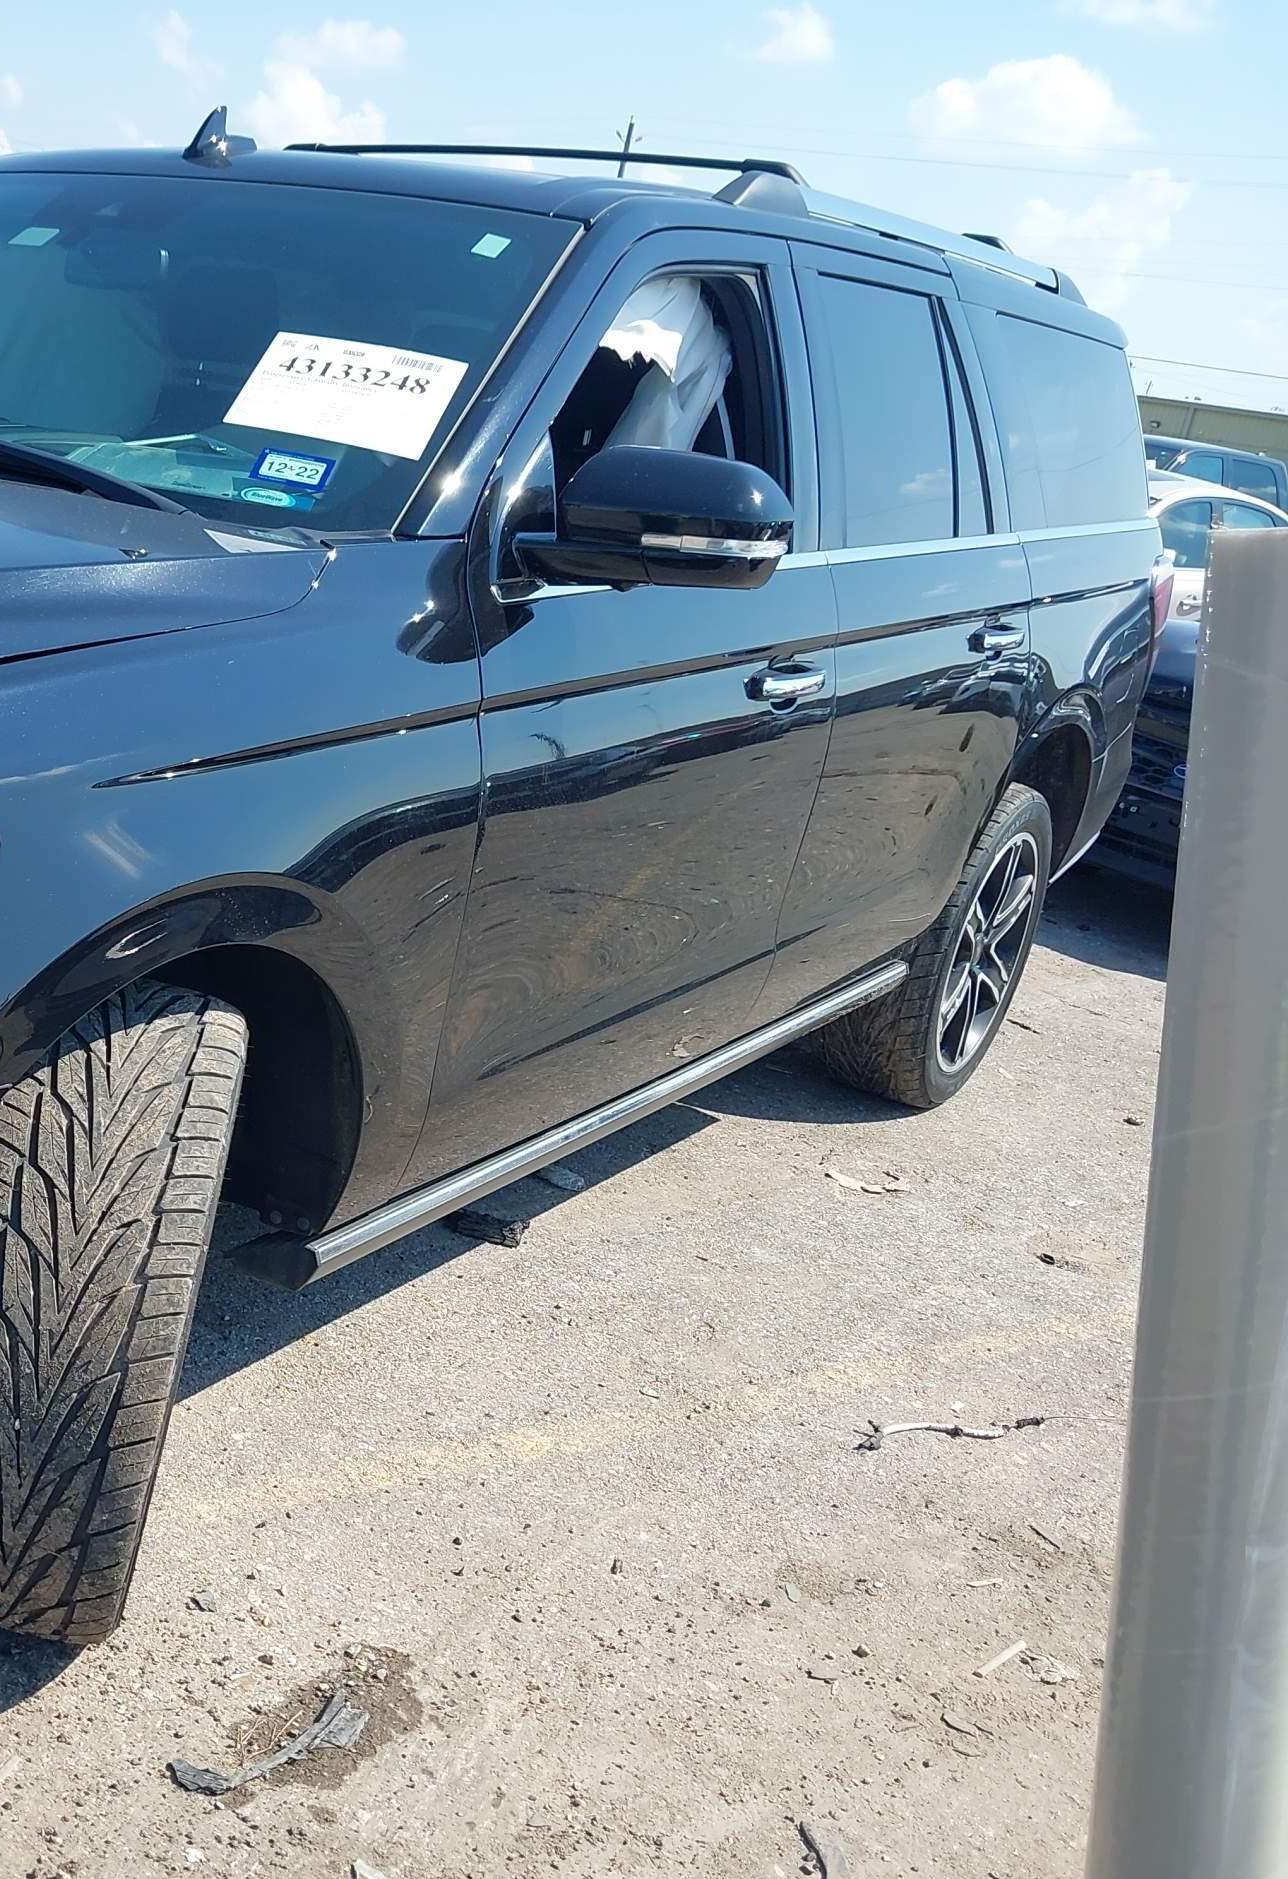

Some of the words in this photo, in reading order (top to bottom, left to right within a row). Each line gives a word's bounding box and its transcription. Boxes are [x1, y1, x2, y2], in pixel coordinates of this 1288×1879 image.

[278, 356, 431, 395] 43133248
[267, 461, 287, 474] 12
[295, 466, 320, 480] 22
